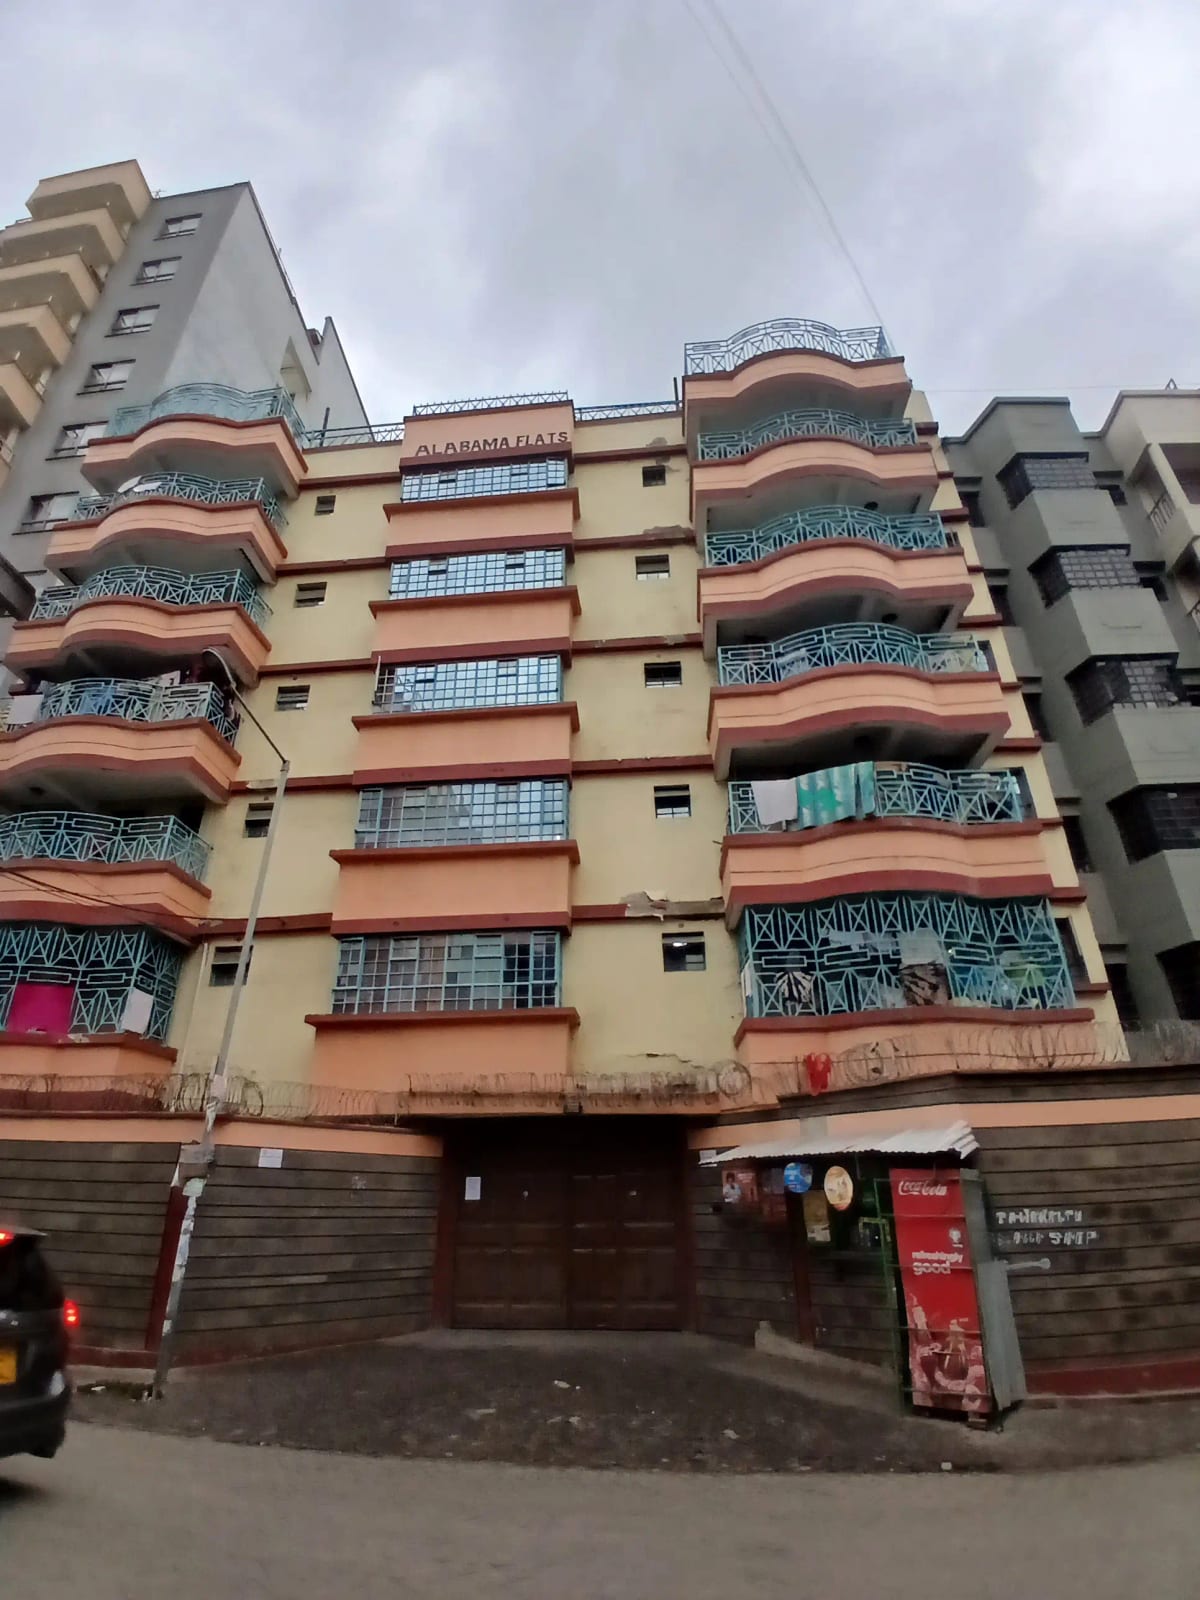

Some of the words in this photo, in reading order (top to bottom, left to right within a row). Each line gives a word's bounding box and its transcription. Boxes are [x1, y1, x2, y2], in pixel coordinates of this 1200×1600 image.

[416, 437, 510, 456] ALABAMA
[516, 431, 568, 447] FLATS
[912, 1260, 951, 1276] good
